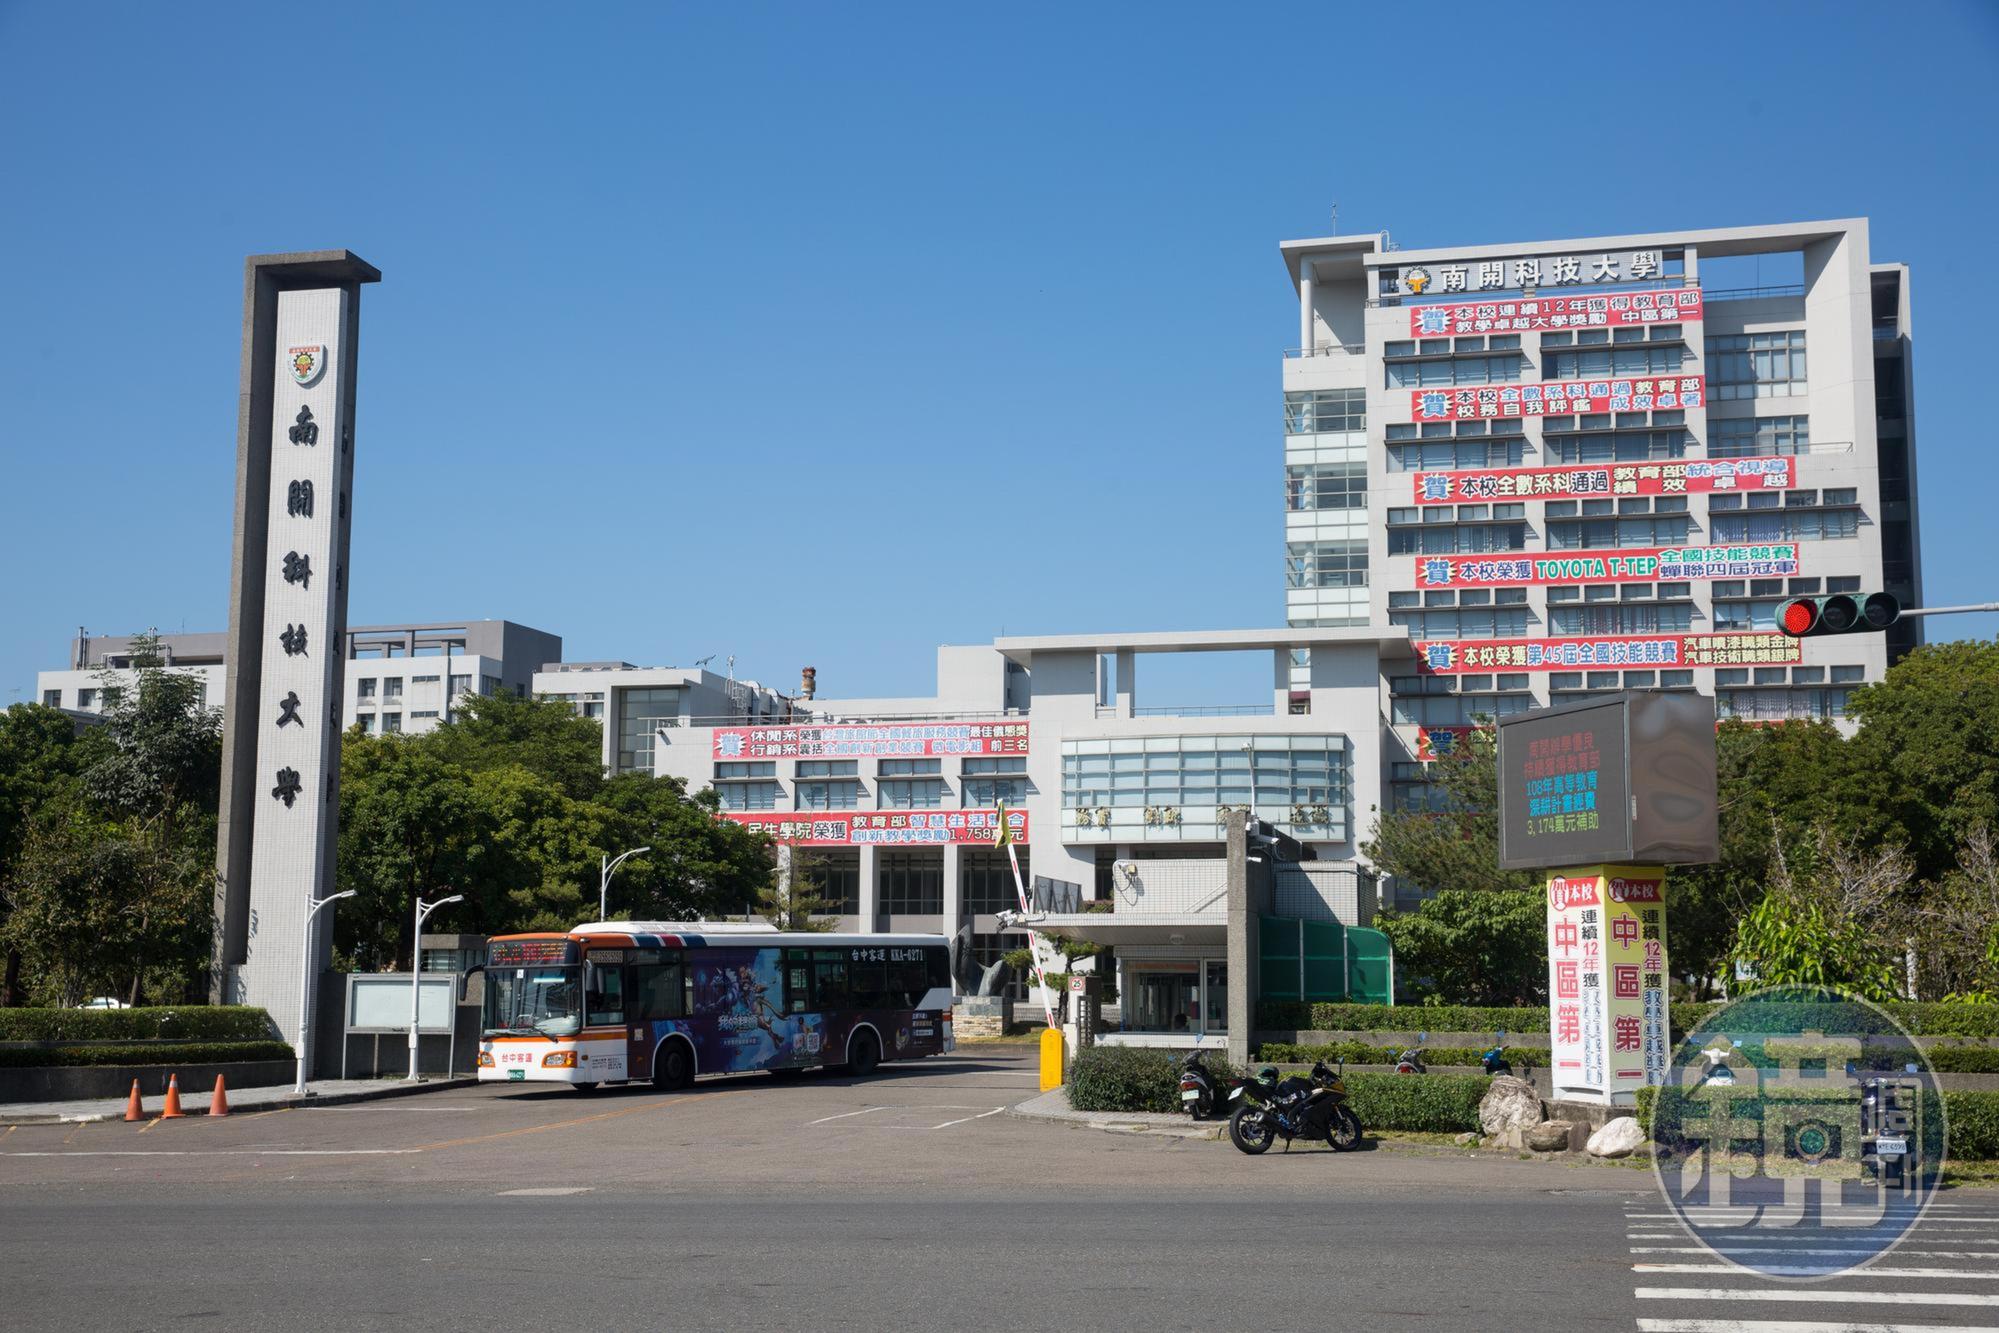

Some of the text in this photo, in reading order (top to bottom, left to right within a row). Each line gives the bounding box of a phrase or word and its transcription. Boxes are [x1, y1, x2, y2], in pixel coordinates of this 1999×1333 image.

[1440, 251, 1658, 291] 南開科技大學
[1455, 292, 1699, 319] 本校連續12年獲得教育部
[1422, 309, 1446, 333] 賀
[1456, 308, 1698, 333] 教學卓越大學獎勵 中區第一
[1456, 378, 1700, 403] 本校全數系科通過教育部
[1422, 392, 1446, 417] 賀
[1457, 392, 1700, 418] 校務自我評鑑 成效卓著
[1613, 459, 1788, 481] 教育部統合視導
[1424, 476, 1447, 500] 賀
[1461, 471, 1609, 497] 本校全數系科通過
[1660, 545, 1794, 563] 全國技能競賽
[1426, 560, 1450, 584] 賀
[1460, 556, 1658, 581] 本校榮獲 TOYOTA T-TEP
[271, 404, 319, 809] 南開科技大學
[1428, 645, 1451, 669] 賀
[1463, 641, 1677, 667] 本校榮獲第45屆全國技能競賽
[991, 739, 1028, 752] 前三名
[1526, 769, 1598, 797] 108年高等教育
[1570, 883, 1593, 902] 本校
[1630, 883, 1654, 899] 本校
[1554, 916, 1582, 1068] 中區第一
[1612, 913, 1644, 1079] 中區第一
